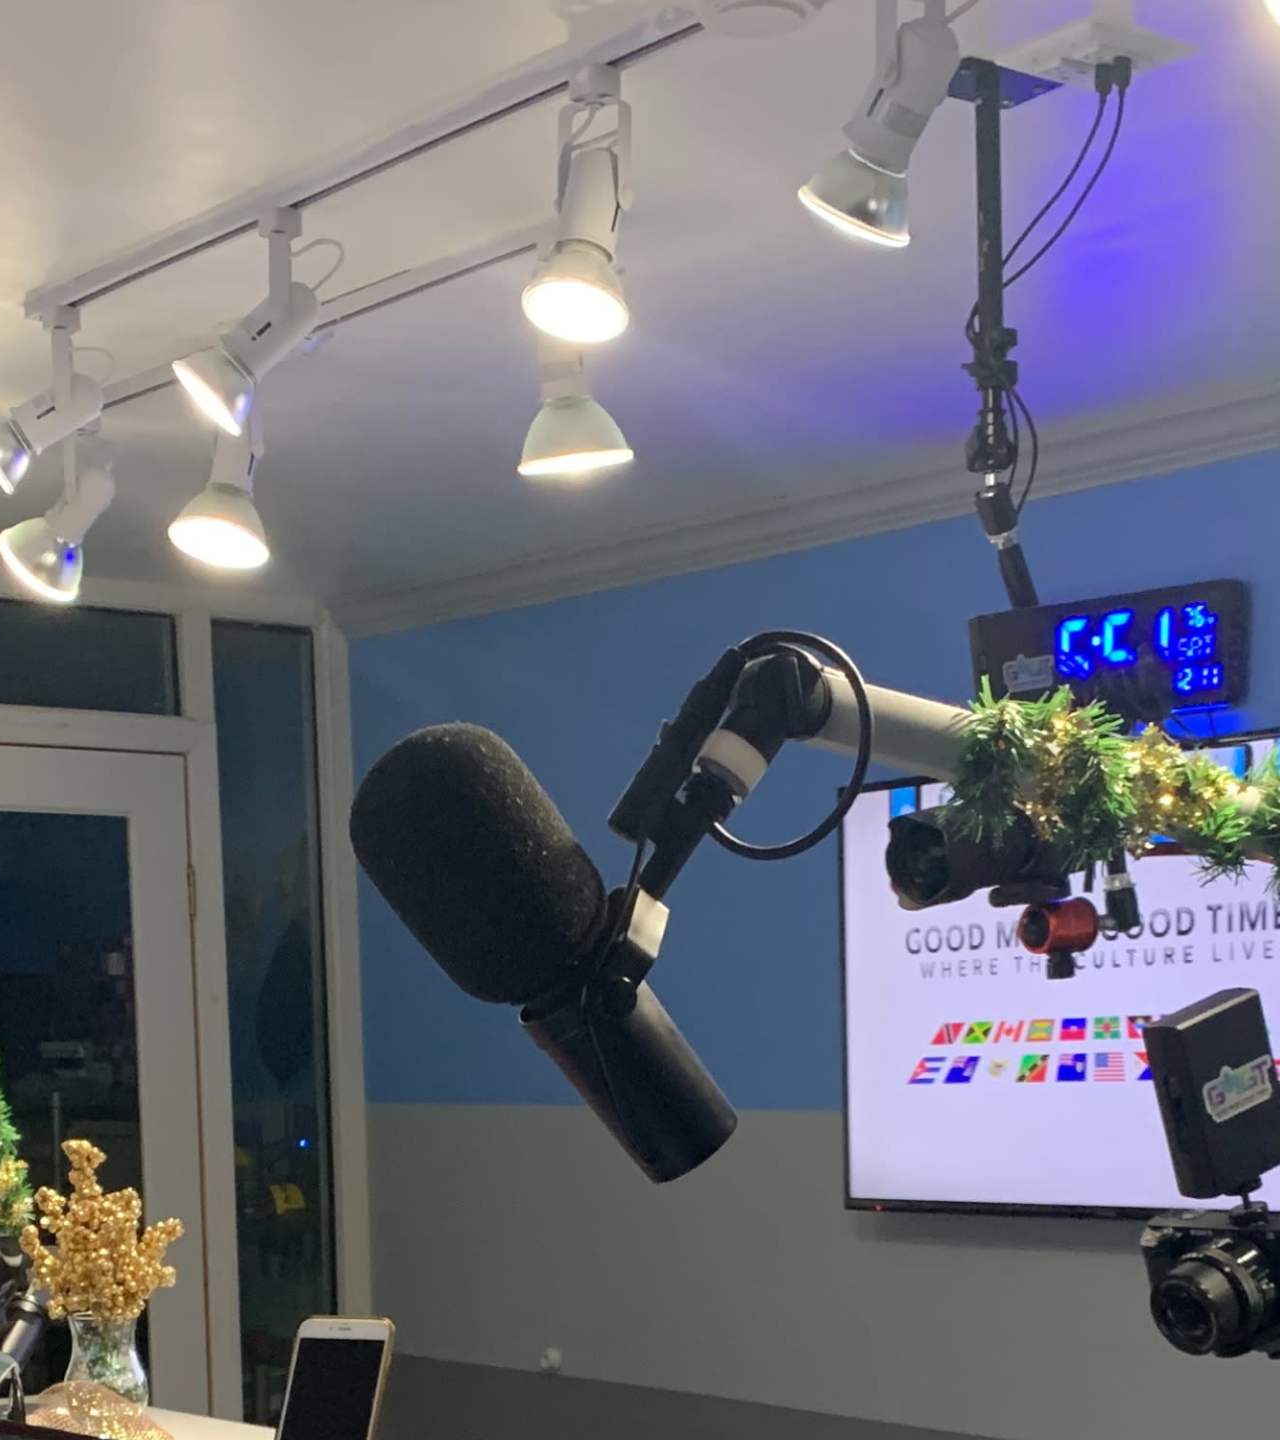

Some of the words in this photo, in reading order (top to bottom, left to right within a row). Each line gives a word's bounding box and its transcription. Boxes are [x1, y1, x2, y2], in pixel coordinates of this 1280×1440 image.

[904, 921, 986, 955] GOOD
[919, 957, 999, 980] WHERE
[1015, 954, 1048, 975] TH
[1074, 944, 1194, 970] CULTURE
